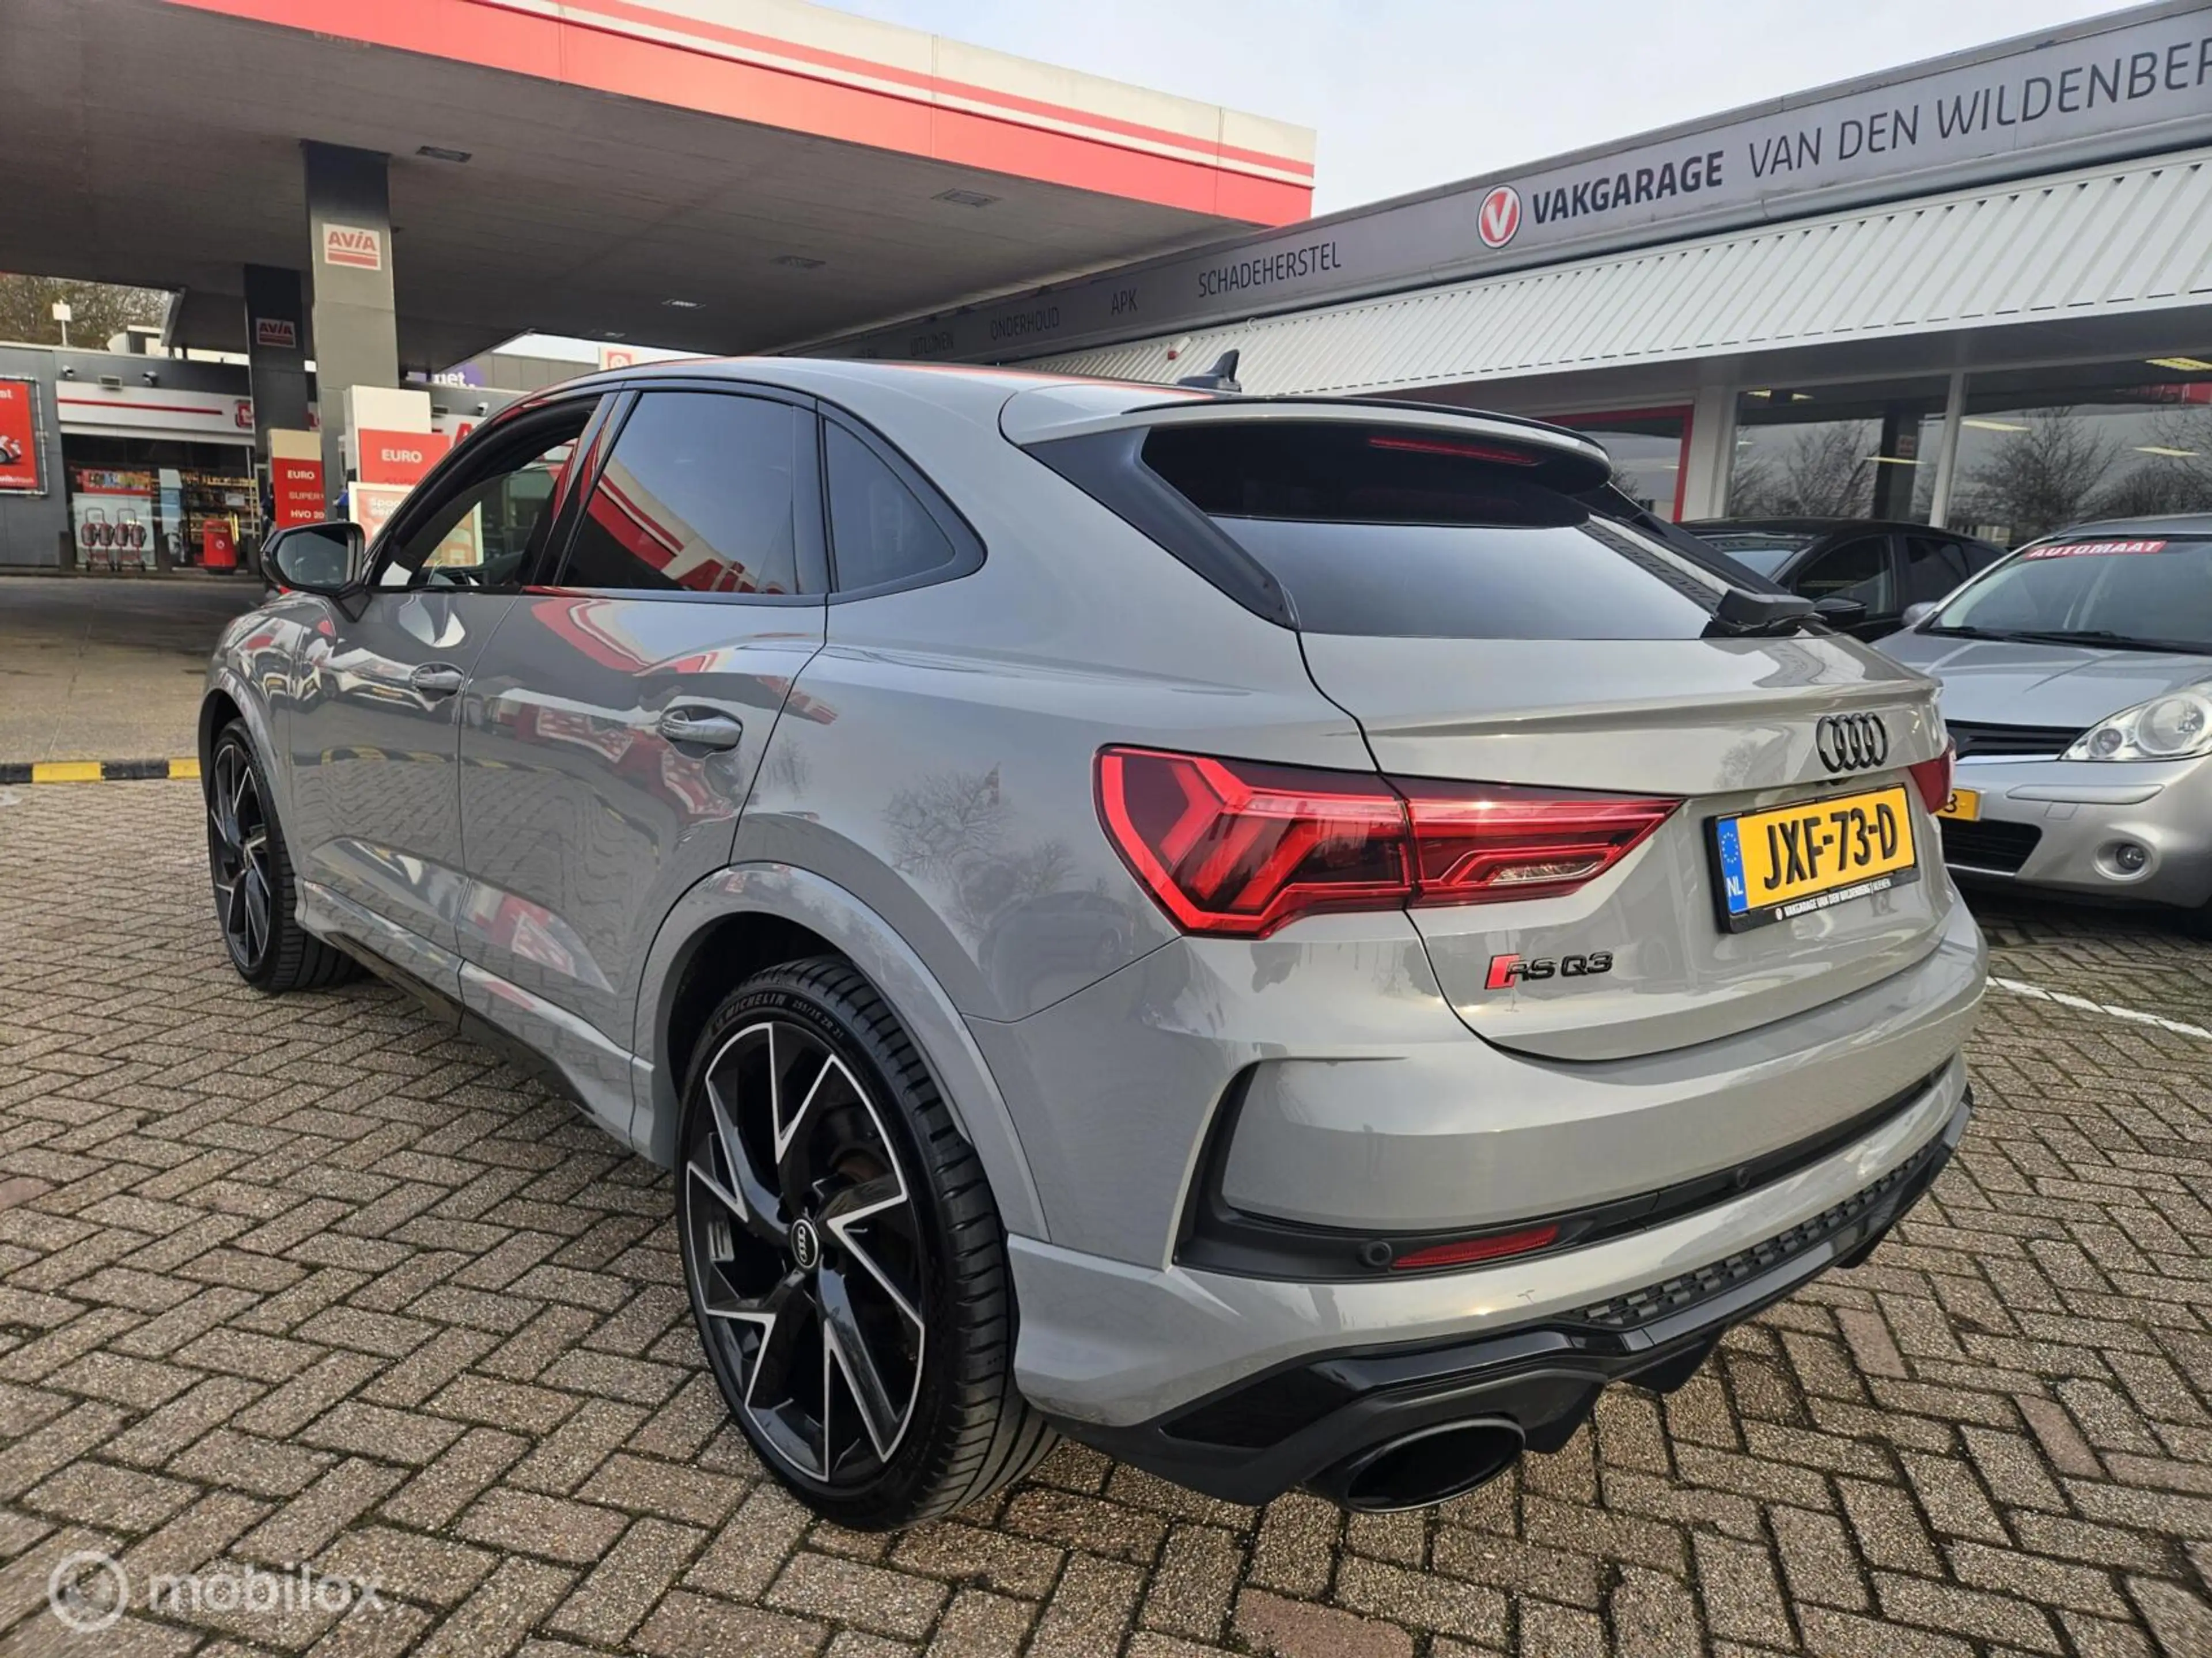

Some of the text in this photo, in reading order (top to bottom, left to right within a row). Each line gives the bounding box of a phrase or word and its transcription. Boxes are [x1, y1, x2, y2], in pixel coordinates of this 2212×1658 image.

[1532, 150, 1724, 225] VAKGARAGE
[1749, 127, 1822, 179] VAN
[1838, 104, 1919, 161] DEN
[1198, 241, 1342, 298] SCHADEHERSTEL
[1111, 288, 1138, 316] APK
[990, 306, 1060, 341] ONDERHOUD
[381, 449, 423, 464] EURO
[287, 469, 315, 480] EURO
[290, 510, 312, 519] HVO
[2028, 541, 2161, 558] AUTOMAAT
[1763, 802, 1898, 890] JXF-73-D
[1727, 877, 1744, 898] NL
[1503, 951, 1613, 983] RS Q3
[726, 993, 787, 1019] MICHELIN
